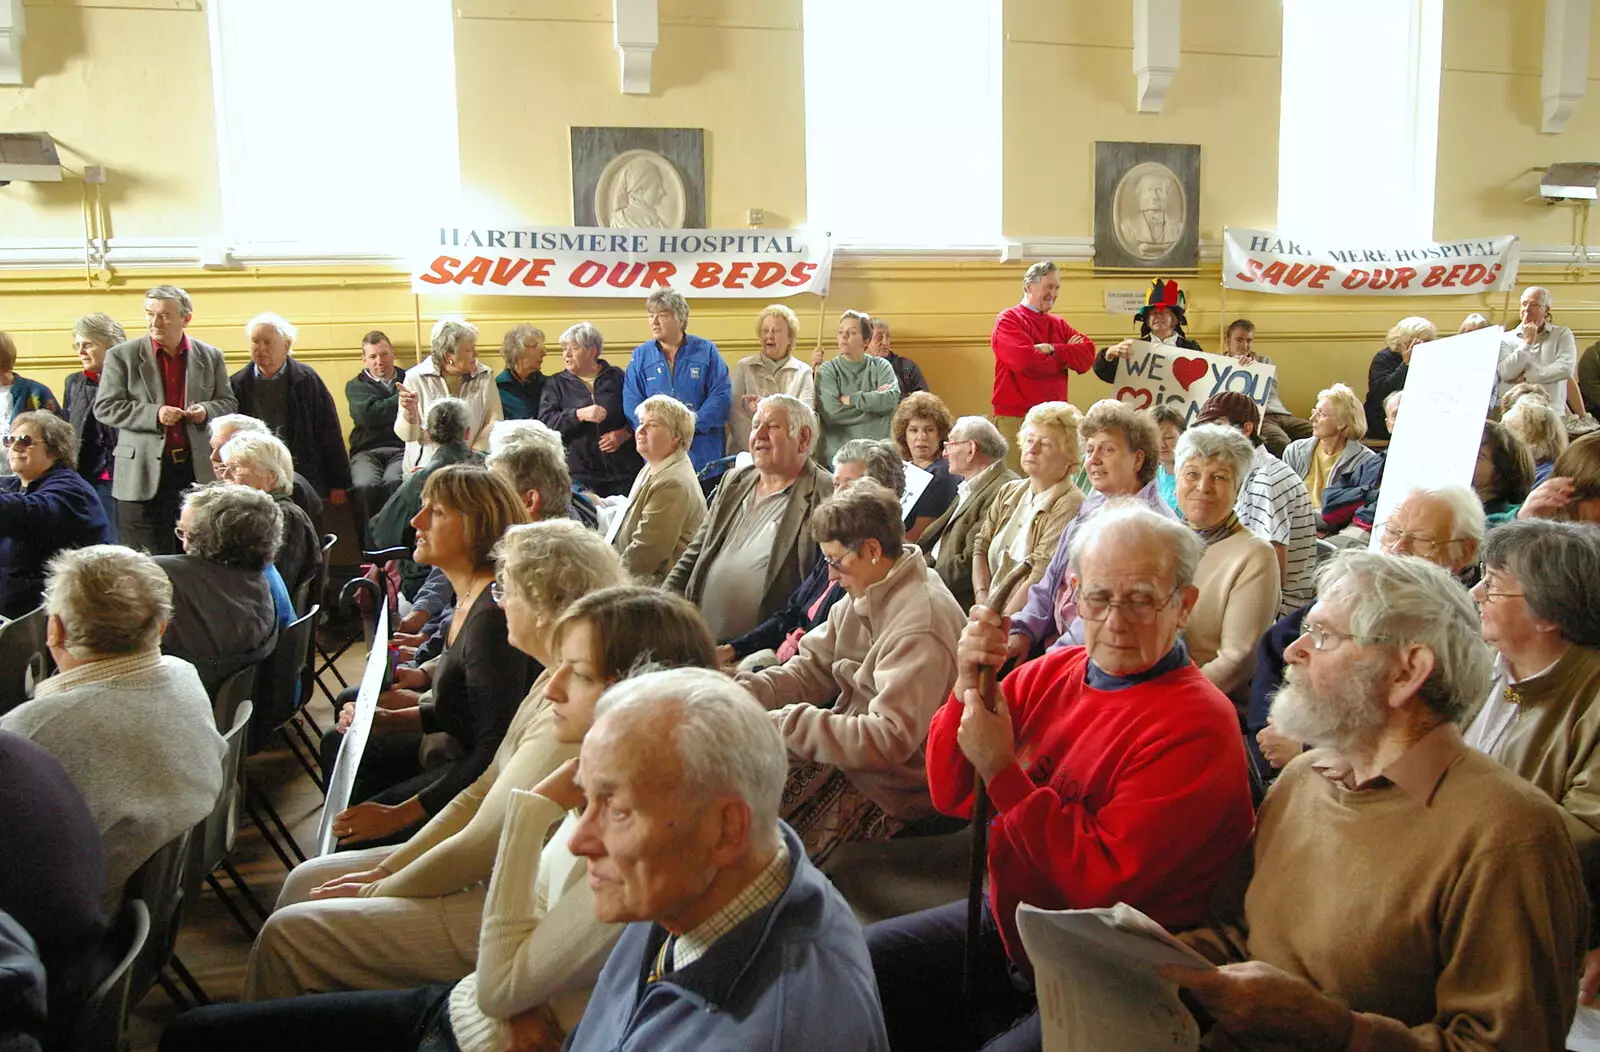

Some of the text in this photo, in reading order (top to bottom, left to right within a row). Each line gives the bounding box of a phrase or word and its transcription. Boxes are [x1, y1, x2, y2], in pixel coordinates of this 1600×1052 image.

[440, 227, 803, 254] HARTISMERE HOSPITAL
[1395, 240, 1500, 263] HOSPITAL
[419, 255, 818, 289] SAVE OUR BEDS
[1235, 257, 1503, 291] SAVE OUR BEDS
[1125, 352, 1273, 405] WE YOU
